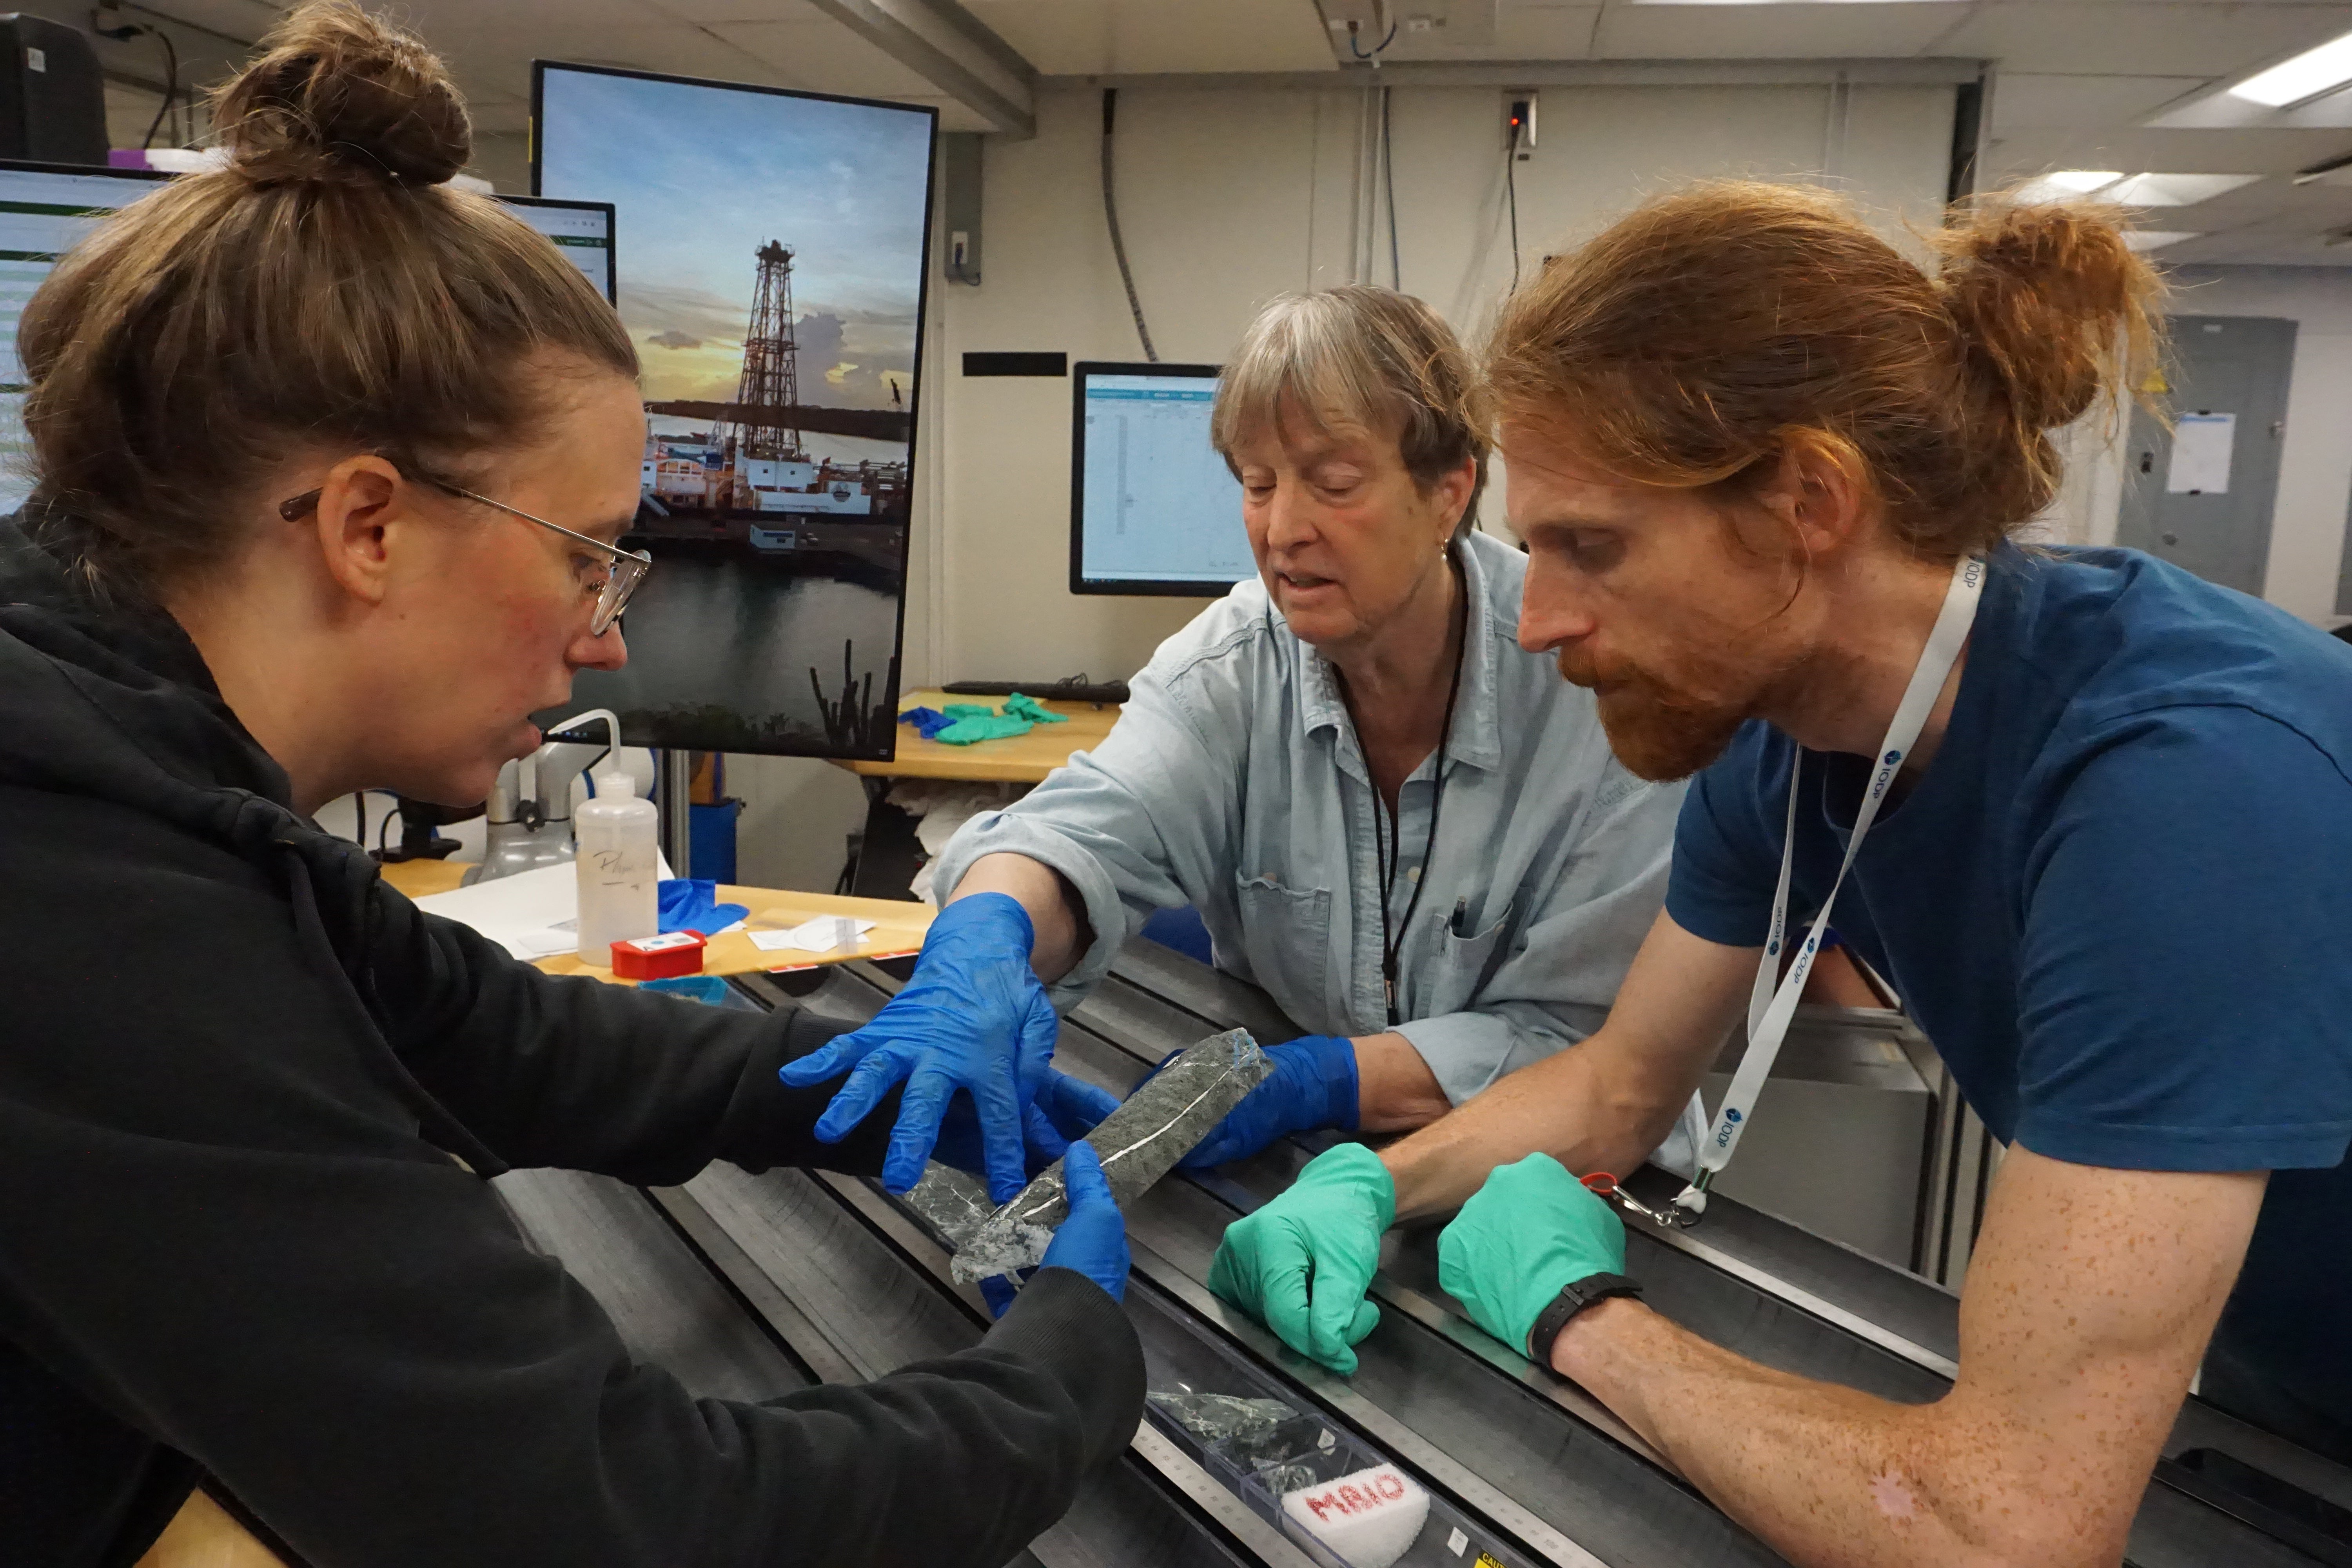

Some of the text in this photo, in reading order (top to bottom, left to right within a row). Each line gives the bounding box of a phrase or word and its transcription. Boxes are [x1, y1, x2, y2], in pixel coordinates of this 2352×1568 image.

[1963, 562, 1980, 588] IODP
[1873, 768, 1891, 799] IODP
[1794, 953, 1809, 984] IODP
[1717, 1122, 1734, 1148] IODP
